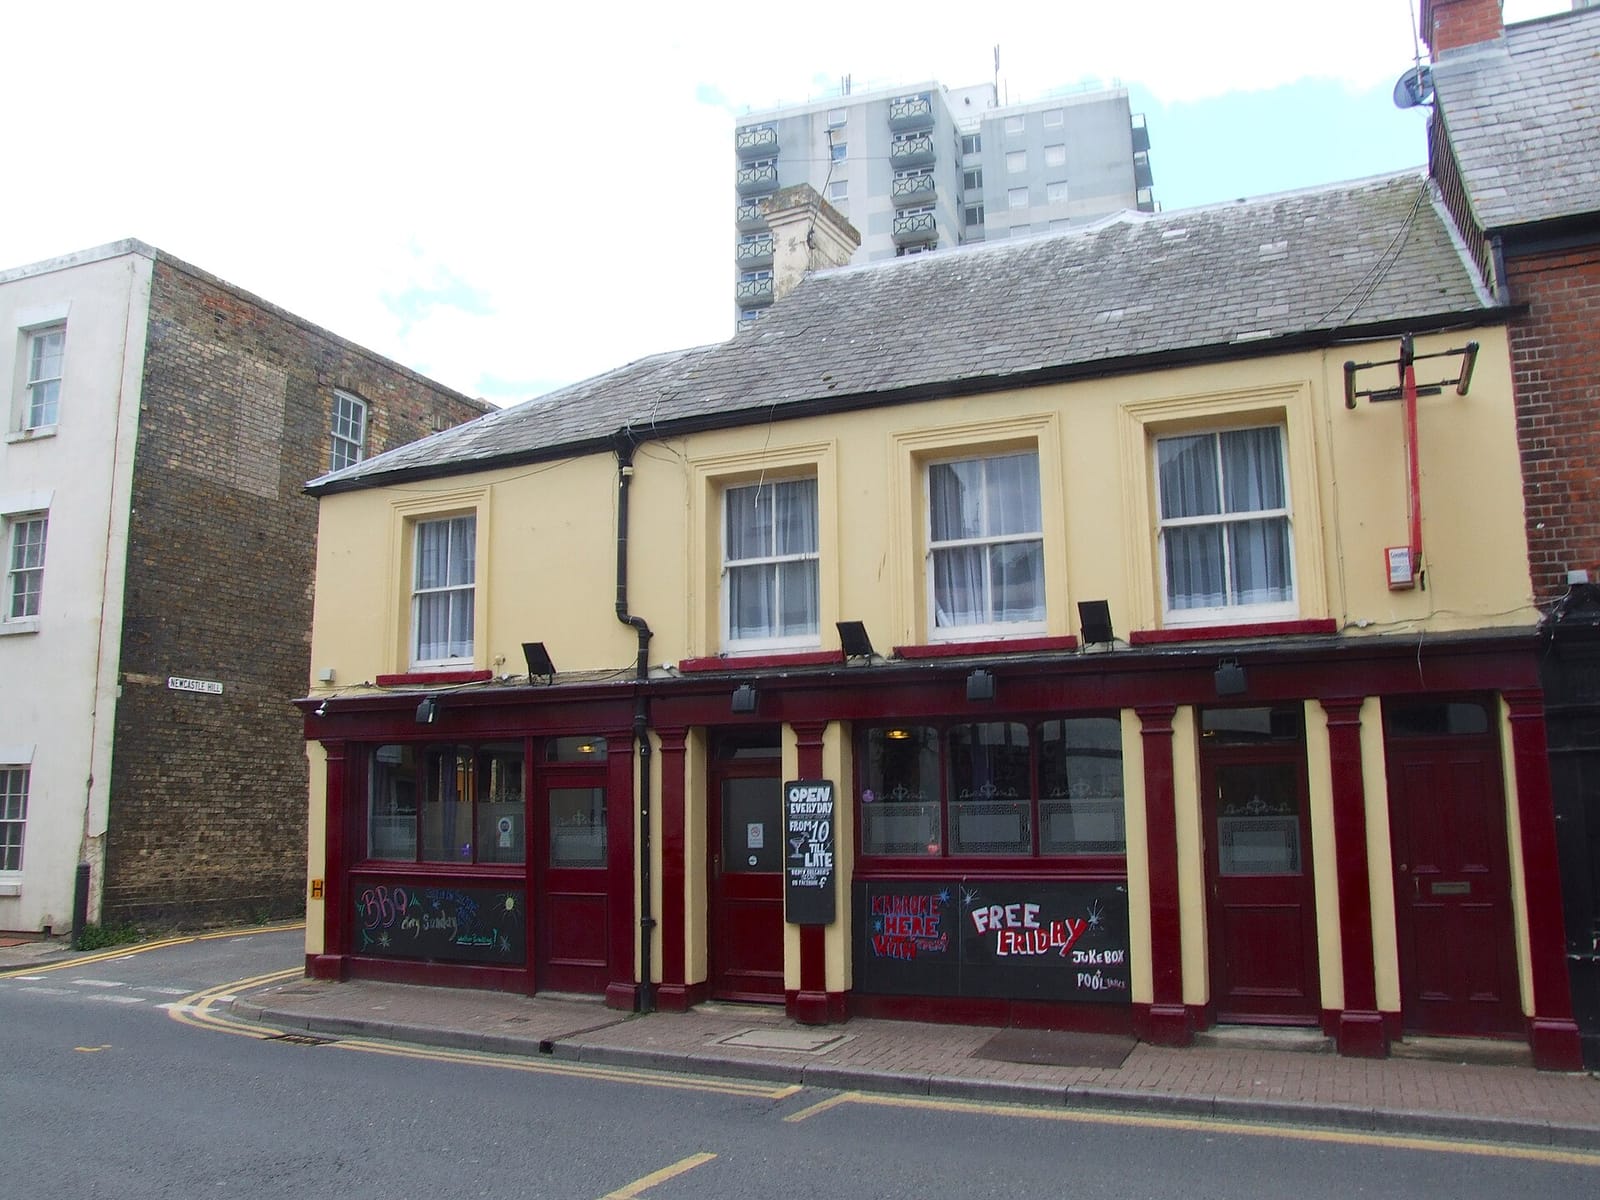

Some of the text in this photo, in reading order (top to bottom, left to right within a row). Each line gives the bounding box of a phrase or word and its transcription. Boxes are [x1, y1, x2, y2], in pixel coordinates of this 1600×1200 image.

[170, 678, 221, 693] NEWCASTLE HILL
[789, 787, 831, 802] OPEN
[789, 820, 811, 832] FROM
[808, 820, 830, 843] 10
[804, 852, 833, 868] LATE
[361, 885, 408, 930] BBQ
[872, 895, 943, 916] KARAOKE
[424, 909, 458, 941] Sunday
[884, 916, 940, 938] HERE
[971, 902, 1041, 936] FREE
[871, 934, 916, 961] WITH
[996, 917, 1089, 957] FRIDAY
[1077, 968, 1107, 990] POOL
